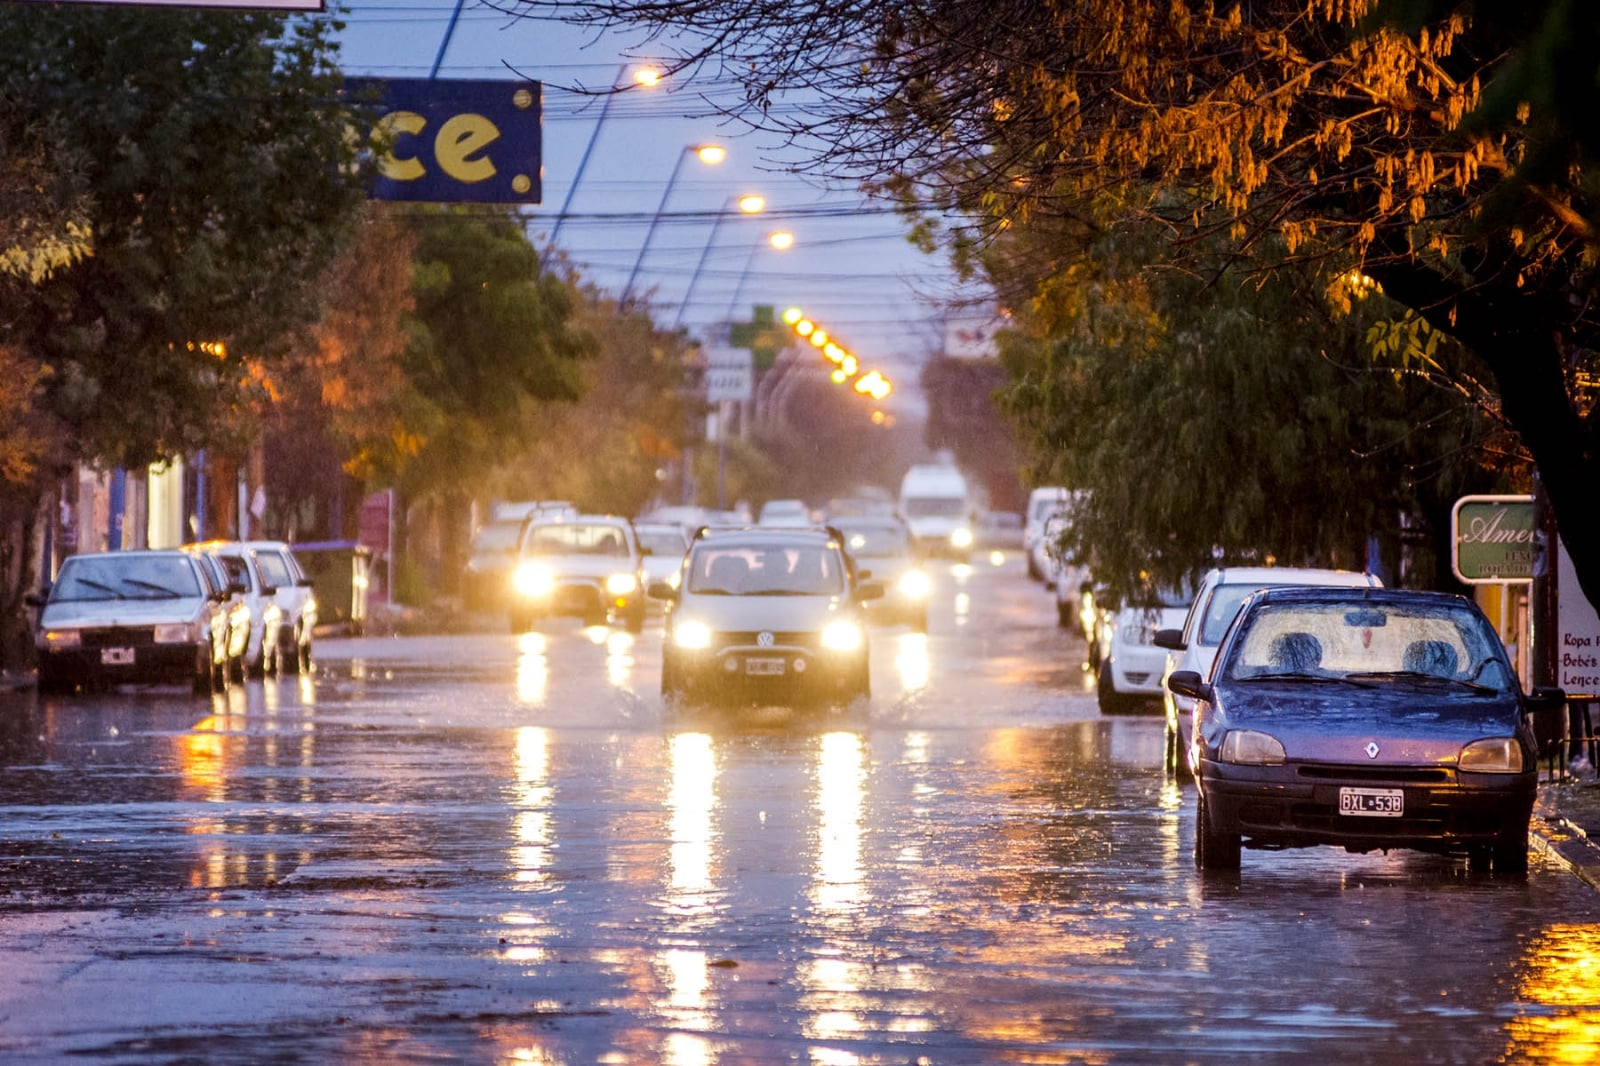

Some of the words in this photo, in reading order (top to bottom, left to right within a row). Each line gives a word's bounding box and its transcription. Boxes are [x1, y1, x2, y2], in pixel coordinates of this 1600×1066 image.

[340, 111, 501, 184] ce
[1564, 633, 1591, 649] Ropa
[1563, 653, 1598, 667] Bebés
[1342, 794, 1367, 811] BXL
